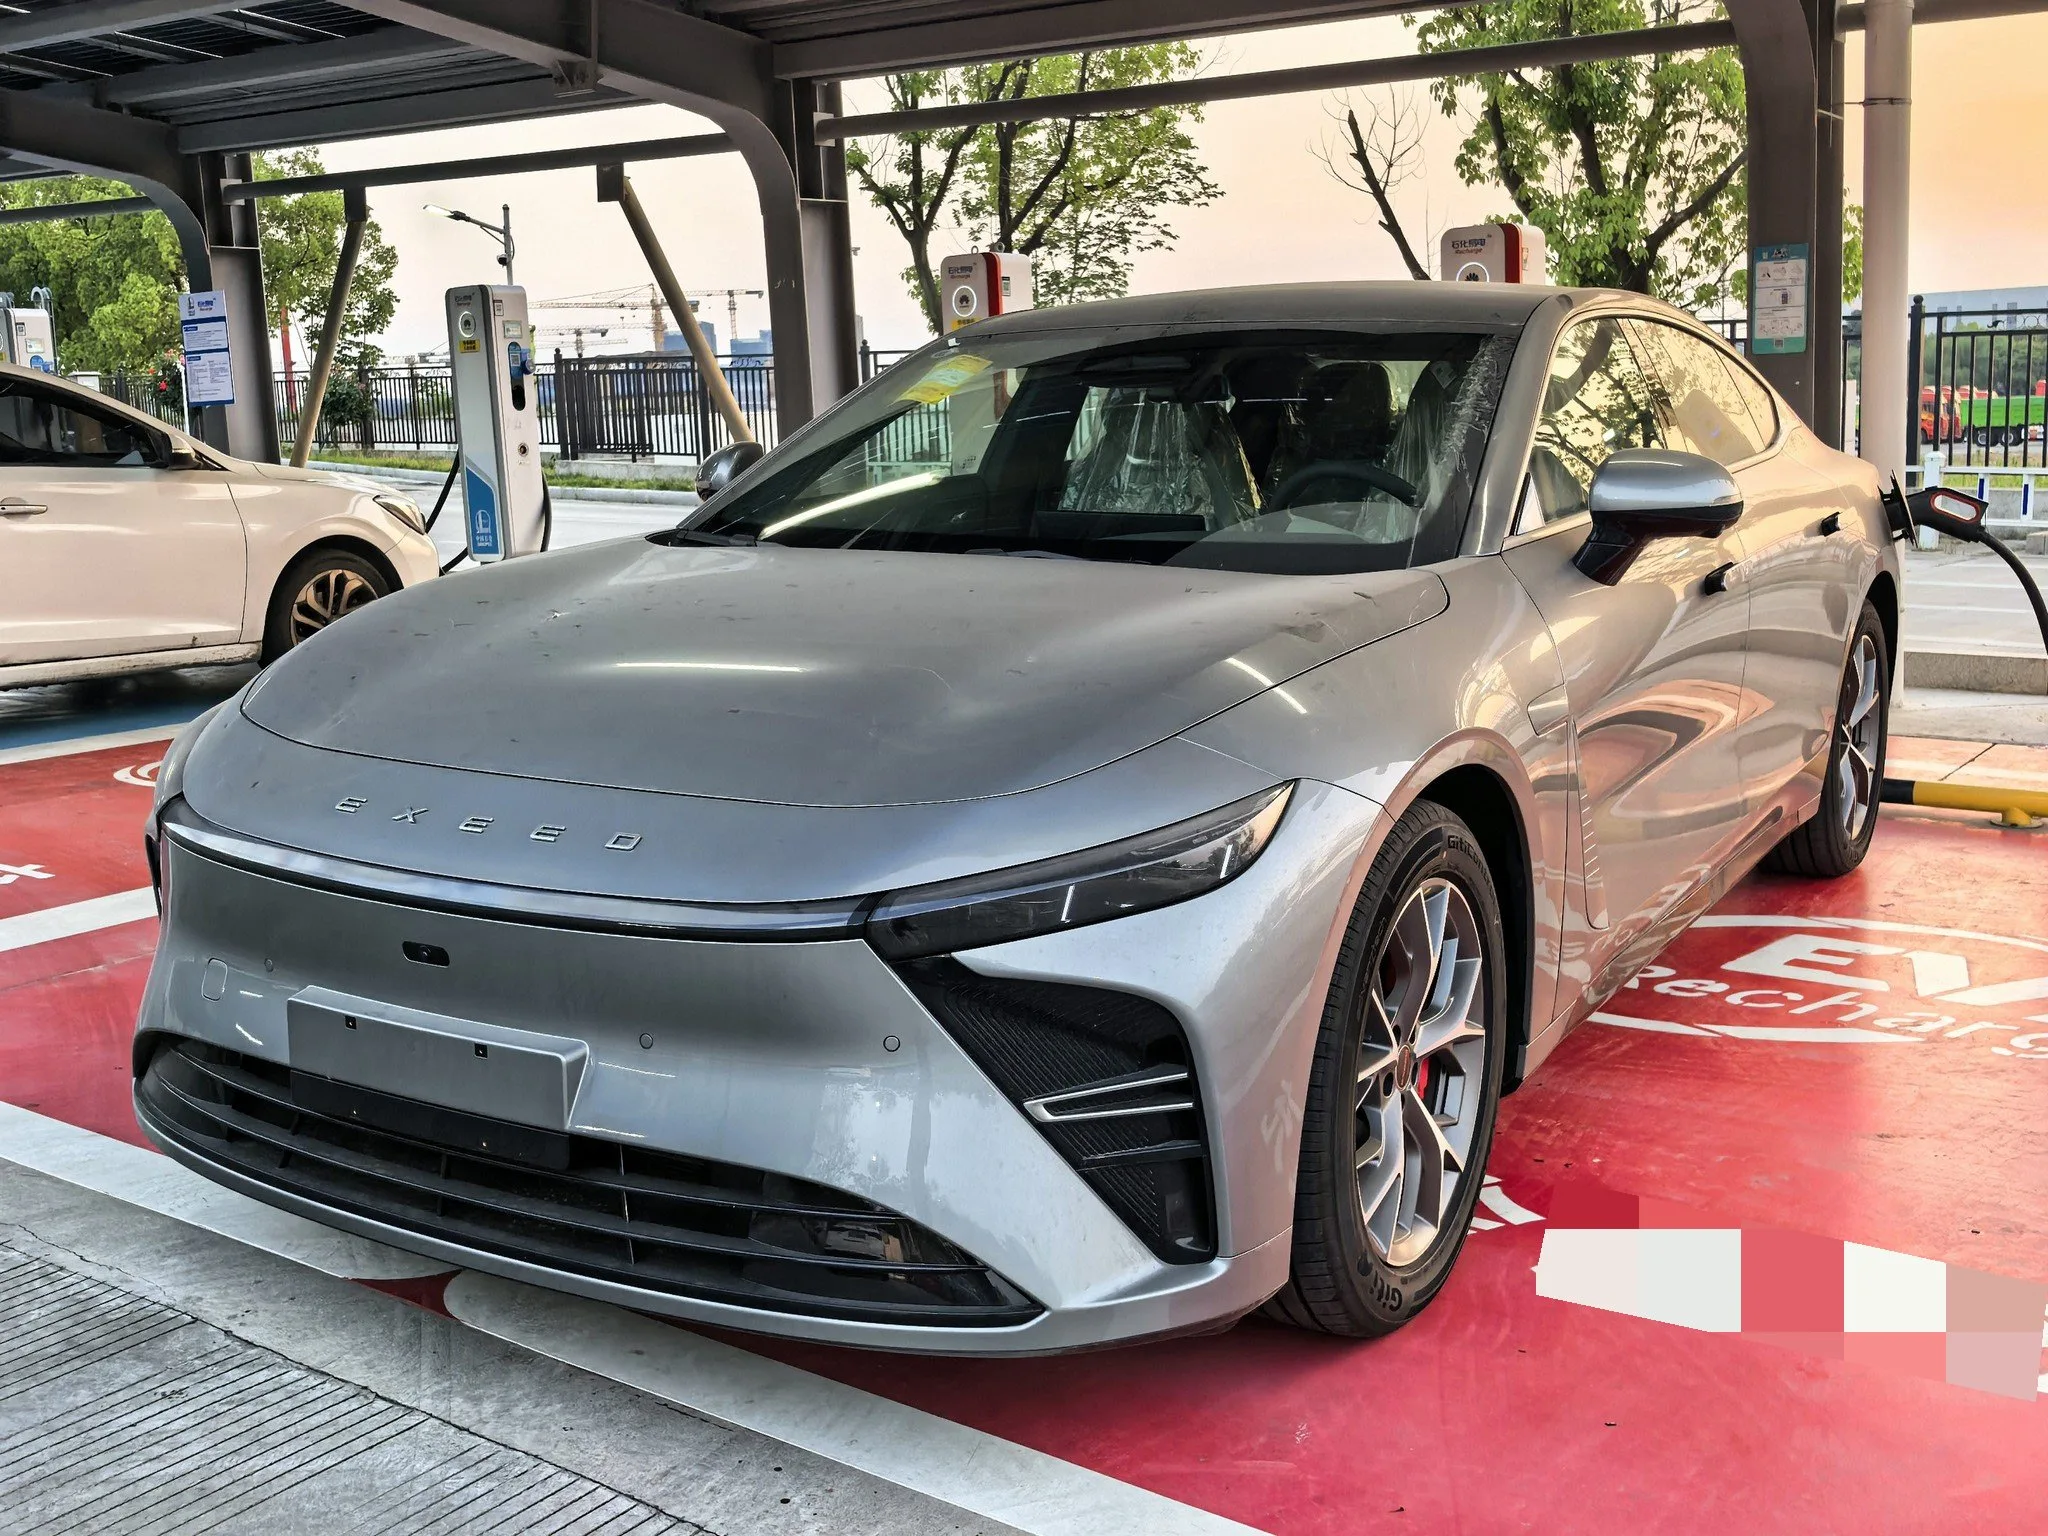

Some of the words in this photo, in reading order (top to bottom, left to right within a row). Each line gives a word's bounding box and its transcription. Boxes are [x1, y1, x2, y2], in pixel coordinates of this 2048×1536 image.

[334, 796, 643, 851] EXEED
[1719, 933, 2048, 1007] EV
[1368, 1269, 1404, 1313] Giti
